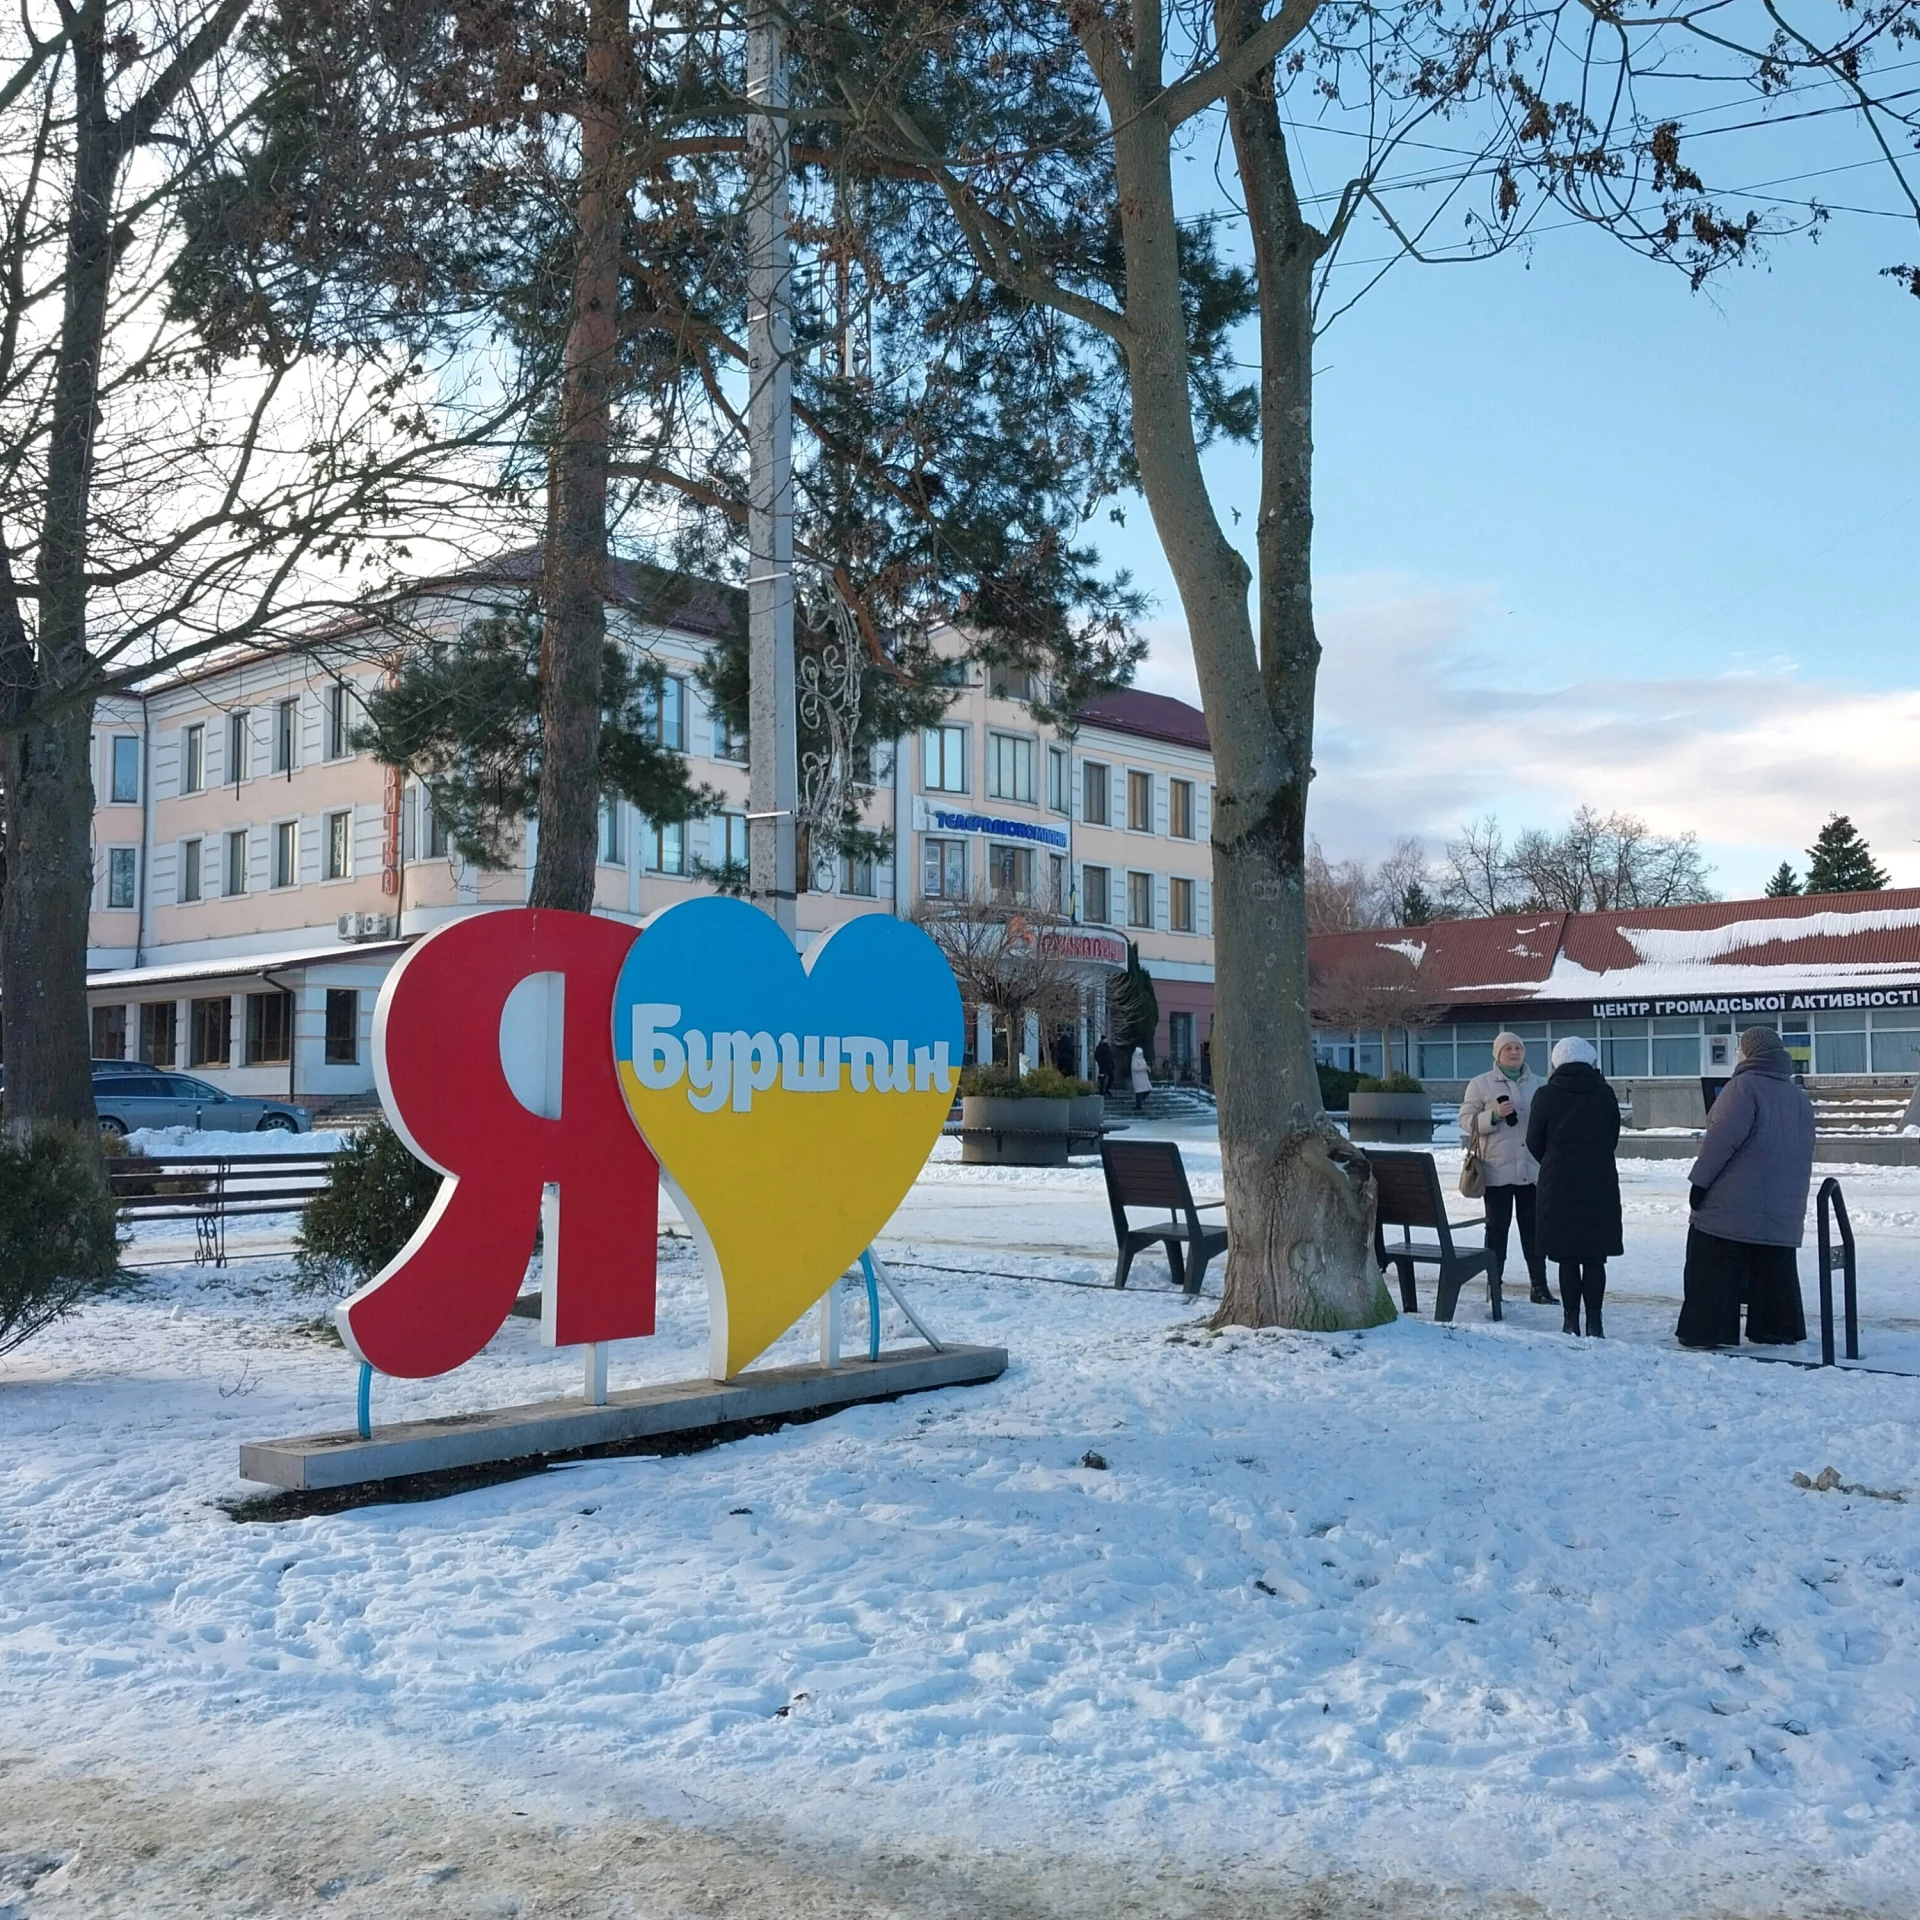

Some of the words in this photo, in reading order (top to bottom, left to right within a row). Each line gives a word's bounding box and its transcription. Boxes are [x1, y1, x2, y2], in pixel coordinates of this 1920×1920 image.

[1593, 1002, 1650, 1019] ЦЕНТР
[1655, 994, 1786, 1014] ГРОМАДСЬКОЇ
[1791, 990, 1919, 1009] АКТИВНОСТІ
[337, 907, 660, 1379] Я
[631, 1002, 952, 1114] Бурштин
